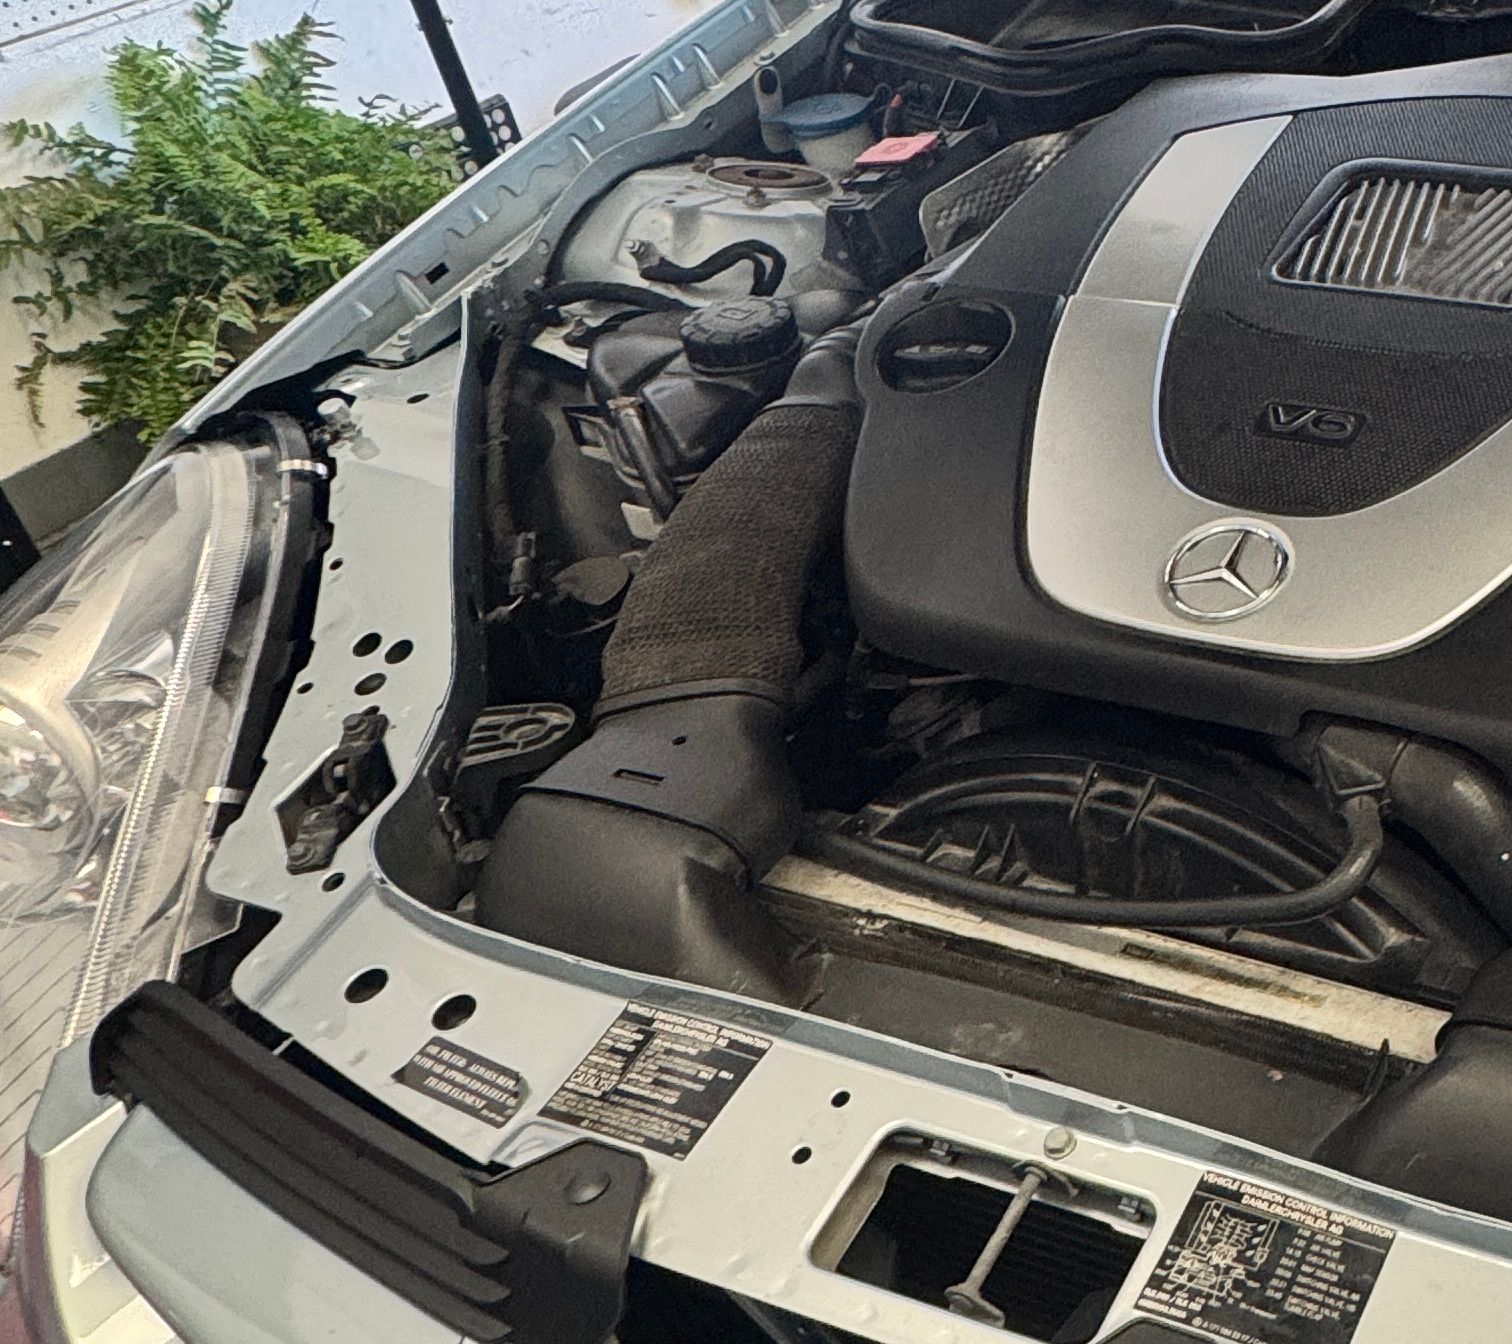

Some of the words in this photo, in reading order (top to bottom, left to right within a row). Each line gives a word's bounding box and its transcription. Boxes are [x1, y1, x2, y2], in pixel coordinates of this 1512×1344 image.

[1267, 404, 1355, 440] V6
[568, 1069, 617, 1093] CATALYST
[1202, 1172, 1240, 1191] VEHICLE
[1239, 1183, 1285, 1205] EMISSION
[1284, 1197, 1330, 1219] CONTROL
[1328, 1211, 1395, 1240] INFORMATION
[1240, 1194, 1329, 1230] DAIMLERCHRYSLER
[1328, 1222, 1345, 1235] AG
